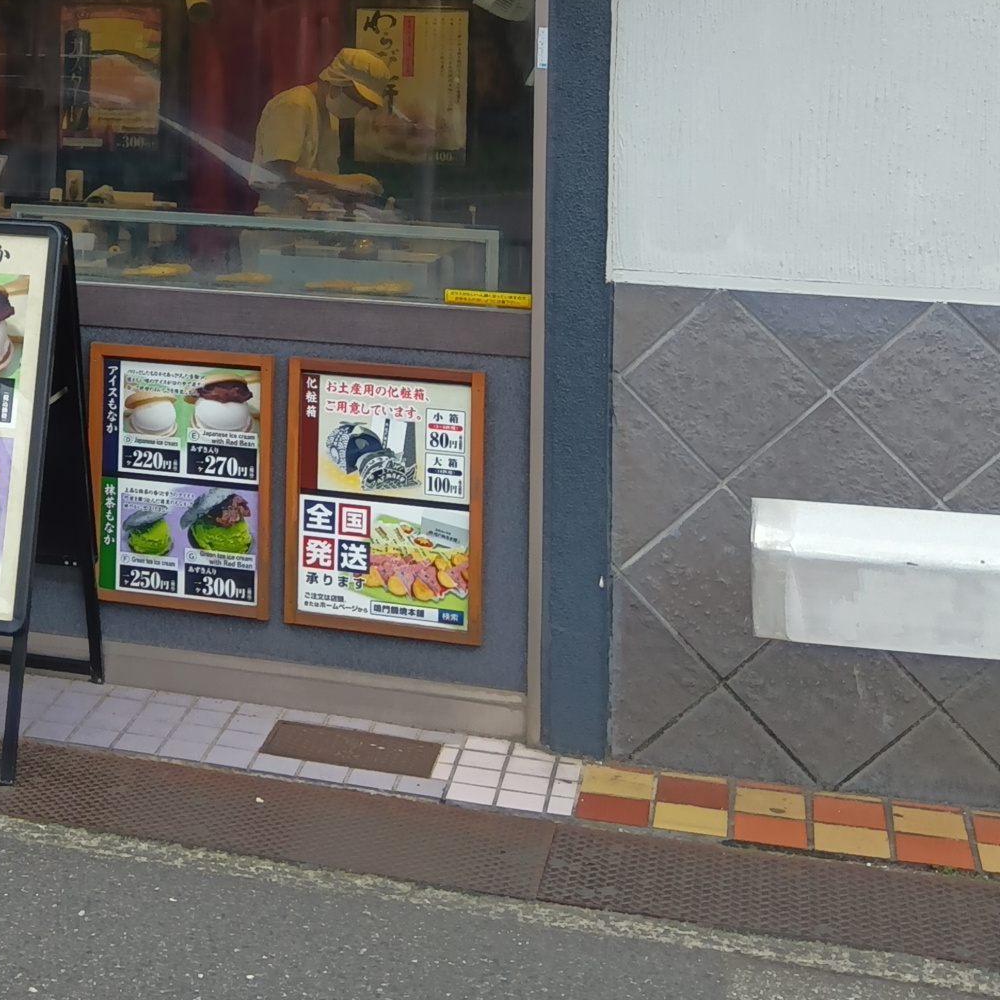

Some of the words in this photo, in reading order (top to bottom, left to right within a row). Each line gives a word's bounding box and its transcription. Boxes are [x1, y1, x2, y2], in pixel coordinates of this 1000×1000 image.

[106, 366, 119, 434] アイスもなか
[306, 377, 318, 418] 化粧箱
[326, 381, 430, 401] お土産用の化粧箱、
[325, 400, 421, 420] ご用意しています。
[134, 437, 156, 446] Japanese
[202, 430, 228, 439] Japanese
[429, 431, 457, 449] 80円
[190, 445, 219, 454] あずき入り
[133, 450, 172, 470] 220円
[204, 455, 248, 477] 270円
[428, 476, 457, 494] 100円
[104, 484, 116, 545] 抹茶もなか
[306, 503, 368, 535] 全国
[306, 539, 368, 571] 発送
[130, 569, 169, 590] 250円
[188, 566, 217, 575] あずき入り
[202, 576, 245, 598] 300円
[306, 572, 365, 590] 承ります
[442, 612, 459, 622] 検索
